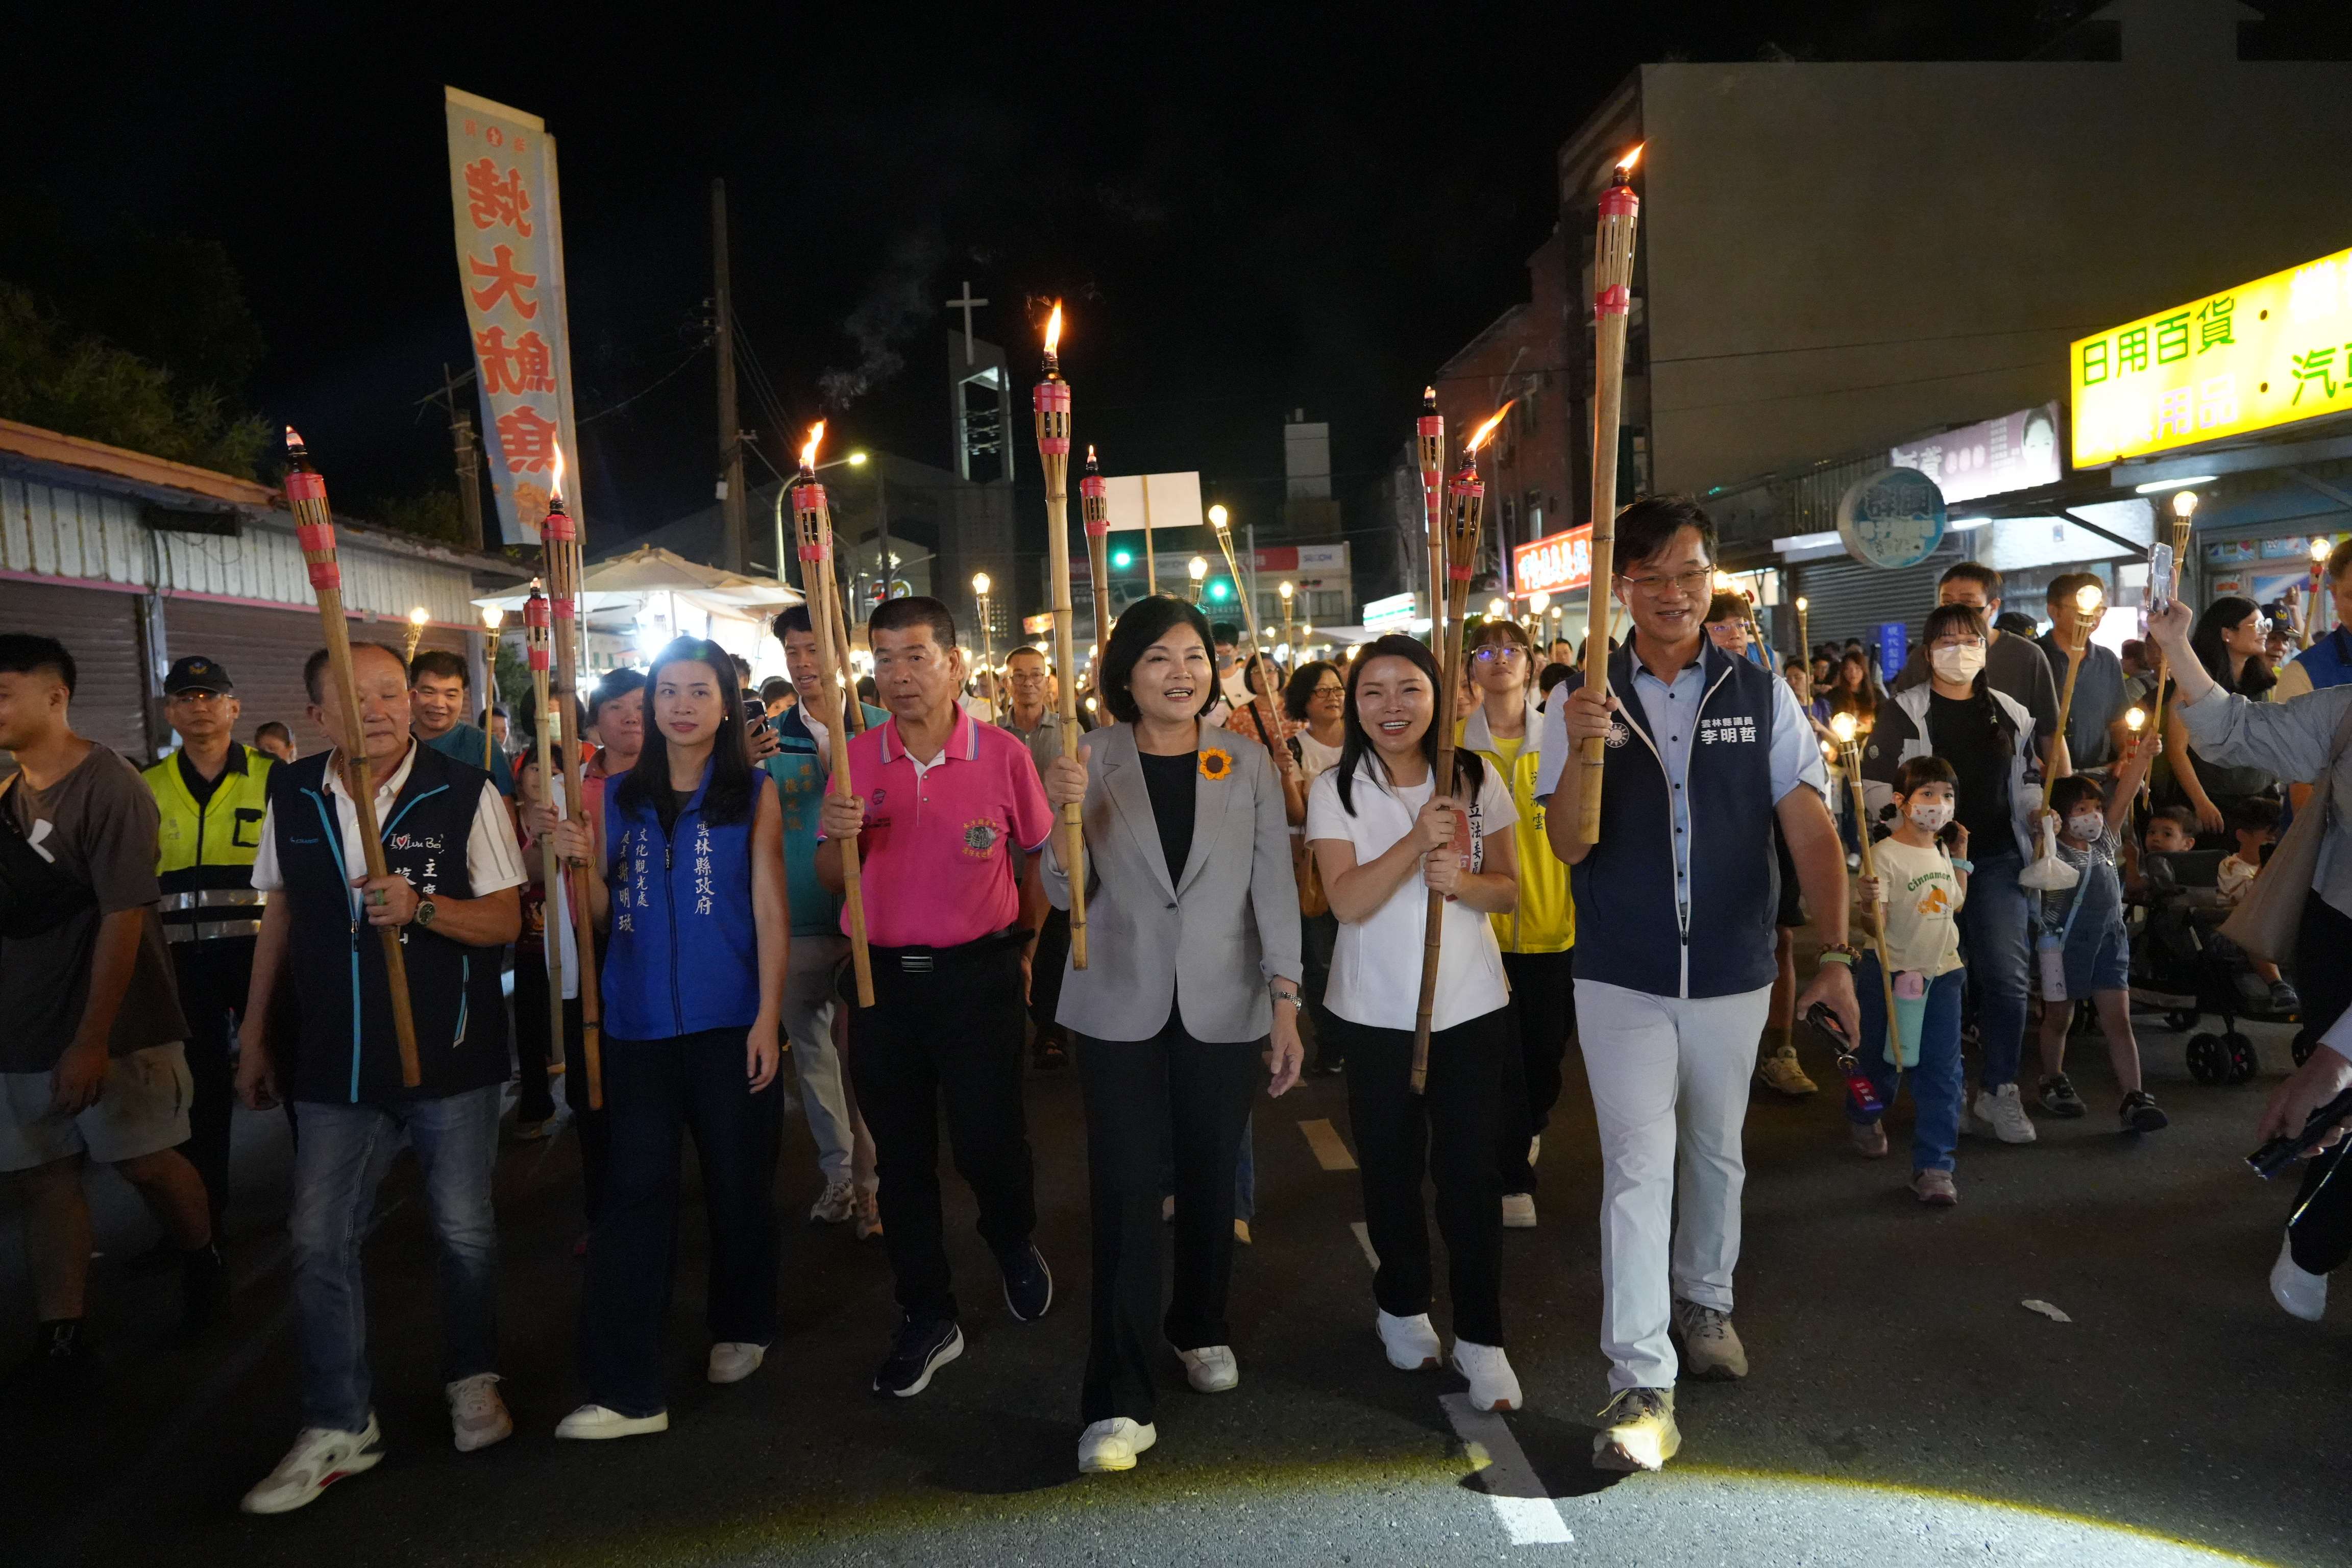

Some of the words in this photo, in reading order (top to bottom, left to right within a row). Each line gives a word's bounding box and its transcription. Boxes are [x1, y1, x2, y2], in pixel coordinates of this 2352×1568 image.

[2083, 296, 2235, 386] 日用百貨
[2291, 342, 2352, 406] 汽
[2081, 373, 2238, 456] 用品
[1701, 716, 1753, 728] 雲林縣議員
[1701, 726, 1756, 745] 李明哲
[635, 828, 649, 908] 文化觀光處
[694, 820, 715, 915] 雲林縣政府
